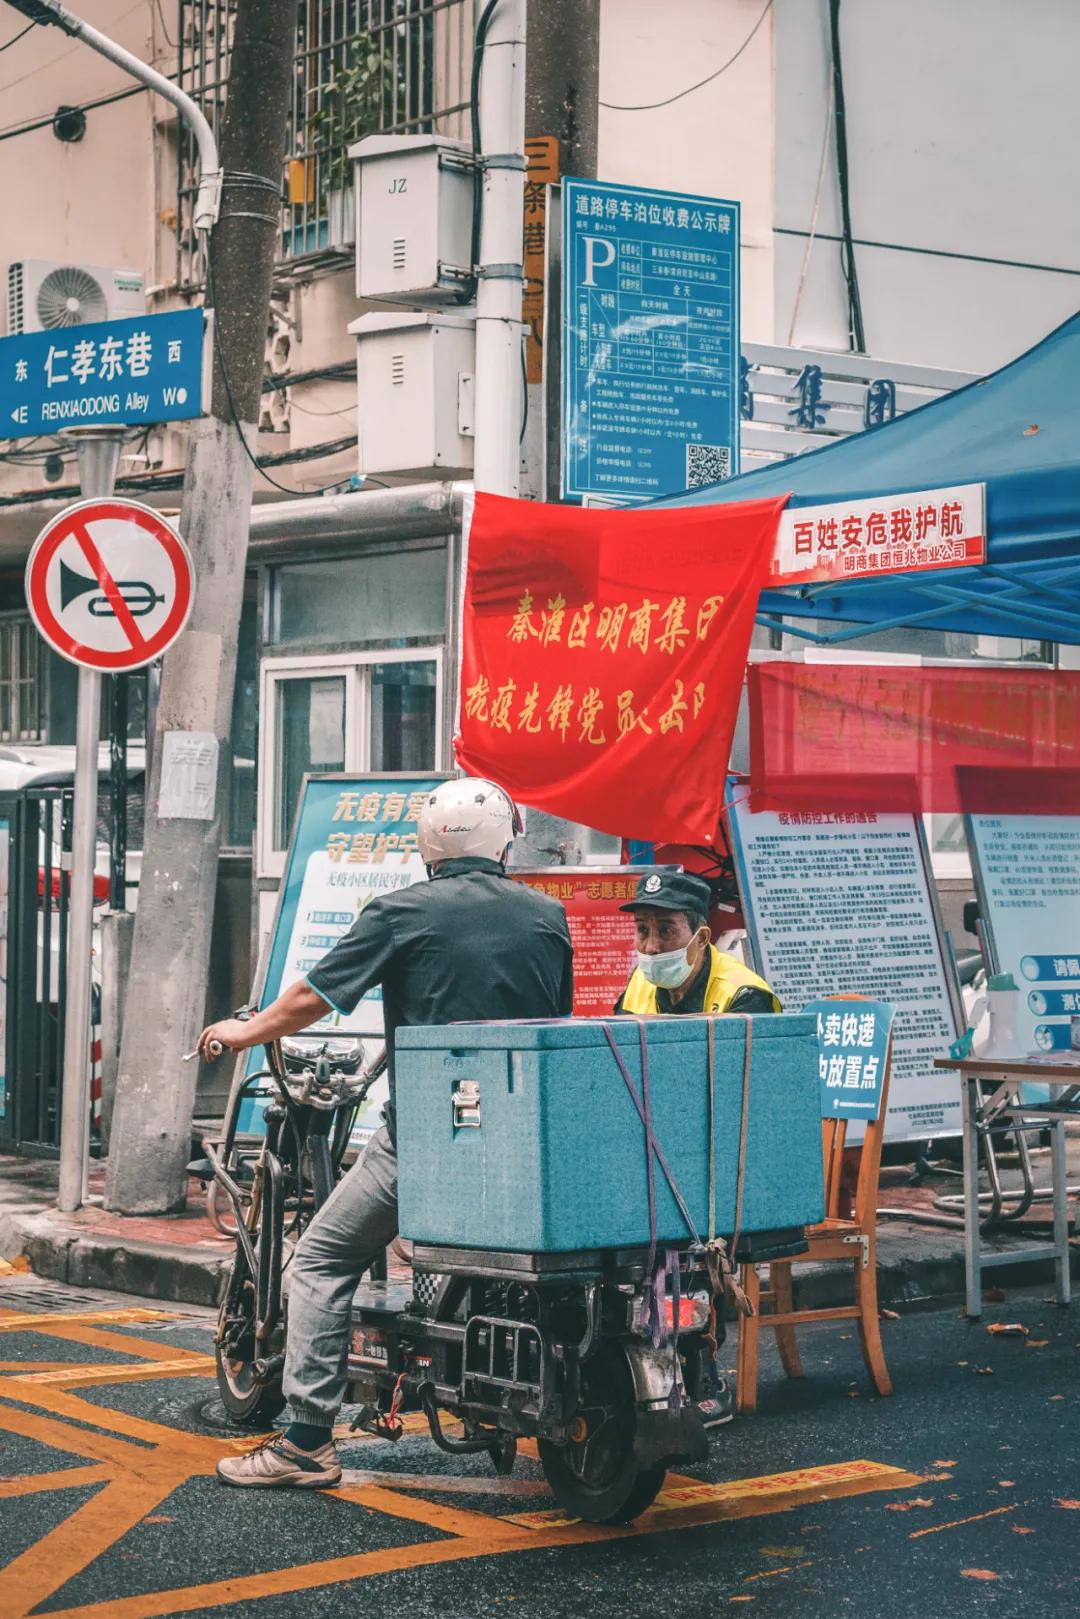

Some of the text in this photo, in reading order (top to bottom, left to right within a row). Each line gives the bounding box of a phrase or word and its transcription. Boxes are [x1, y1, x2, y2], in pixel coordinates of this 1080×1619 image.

[388, 178, 407, 194] JZ
[576, 194, 732, 235] 道路停车泊位收费公示牌
[582, 236, 616, 287] P
[44, 331, 152, 388] 仁孝东巷
[168, 340, 182, 364] 西
[15, 359, 28, 382] 东
[20, 406, 28, 424] E
[42, 395, 119, 420] RENXIAODONG
[125, 392, 149, 414] Alley
[794, 501, 963, 556] 百姓安危我护航
[844, 543, 965, 571] 明商集团恒兆物业公司
